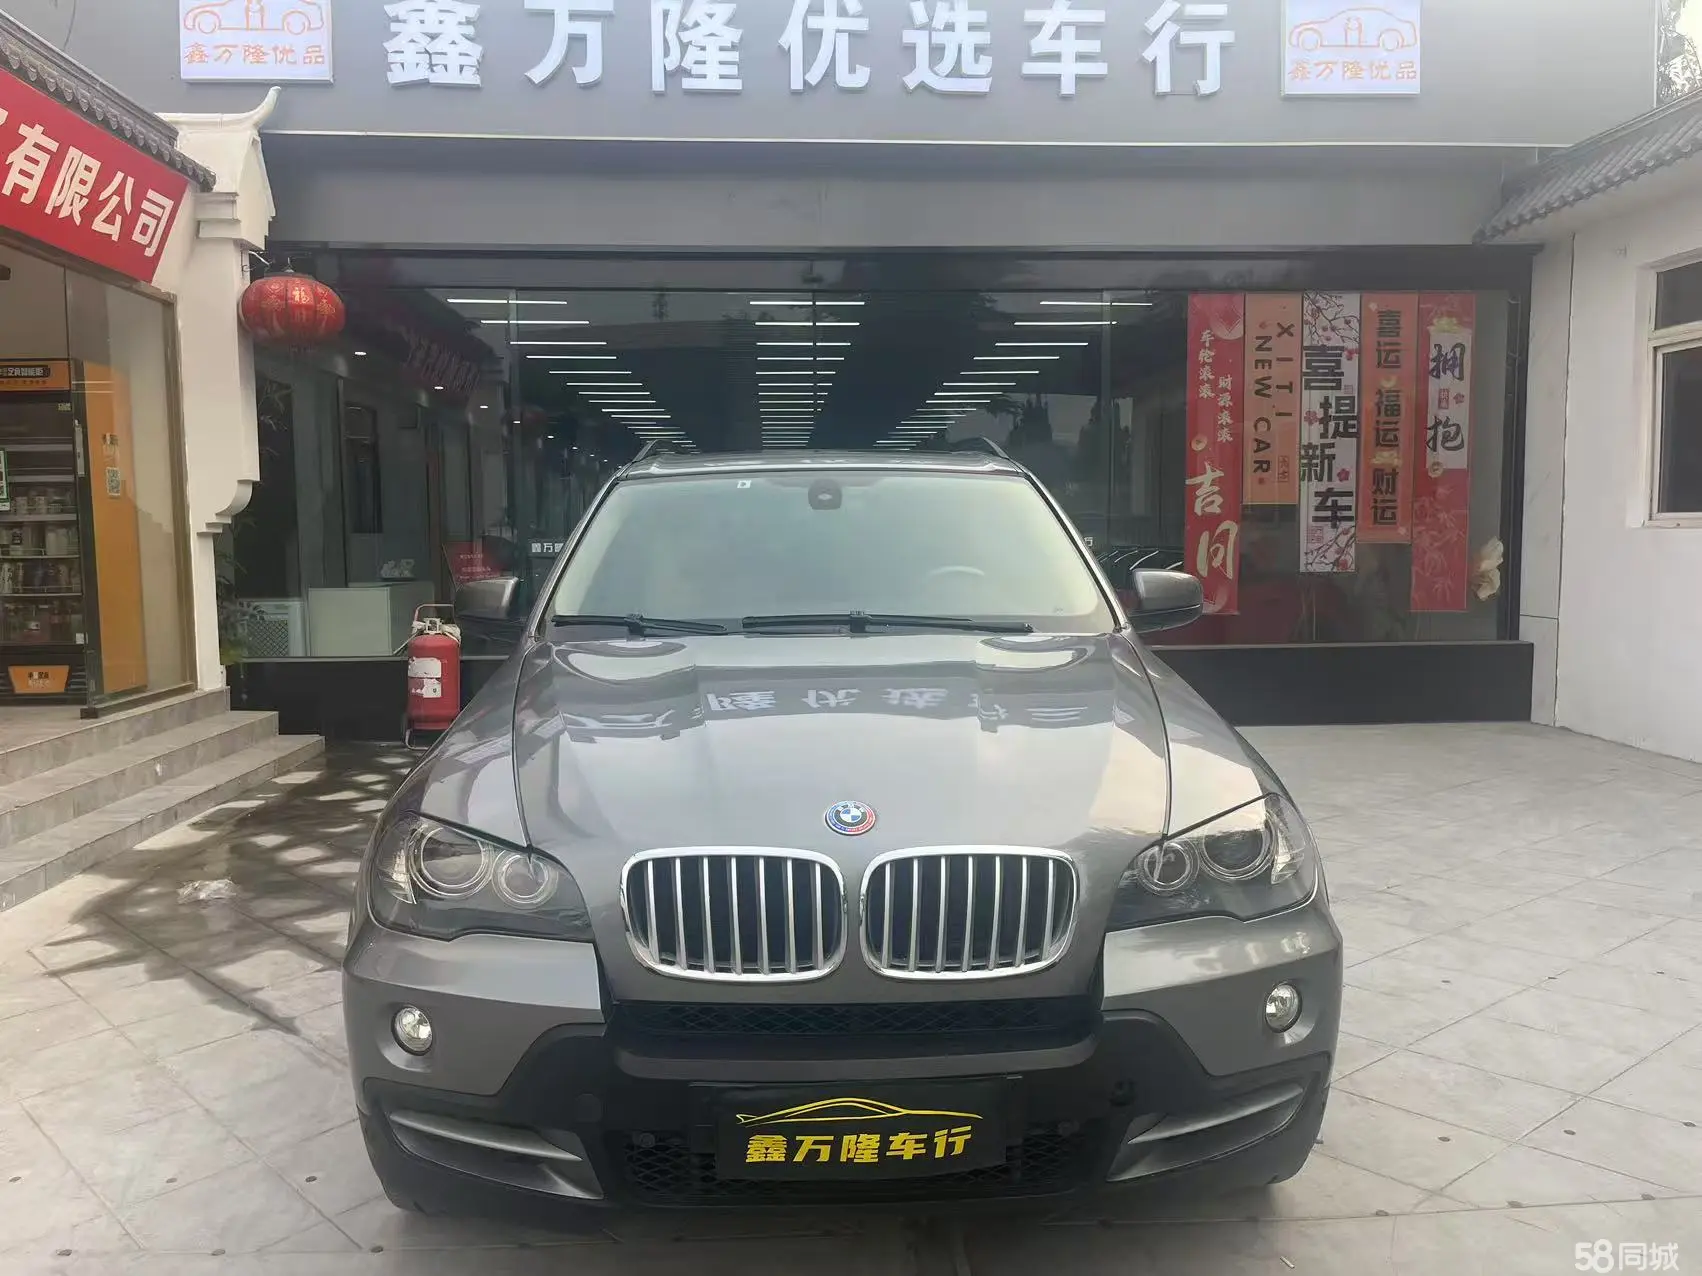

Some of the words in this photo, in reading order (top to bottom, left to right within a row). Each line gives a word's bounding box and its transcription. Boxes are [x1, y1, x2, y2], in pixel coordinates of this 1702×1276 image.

[184, 42, 326, 65] 鑫万隆优品
[383, 0, 1236, 97] 鑫万隆优选车行
[0, 108, 174, 258] 有限公司
[1254, 335, 1273, 399] NEW
[1376, 309, 1402, 369] 喜运
[1374, 388, 1401, 448] 福运
[1424, 342, 1466, 453] 拥抱
[1252, 416, 1273, 474] CAR
[1301, 343, 1360, 530] 喜提新车
[1370, 467, 1399, 526] 财运
[745, 1125, 973, 1164] 鑫万隆车行
